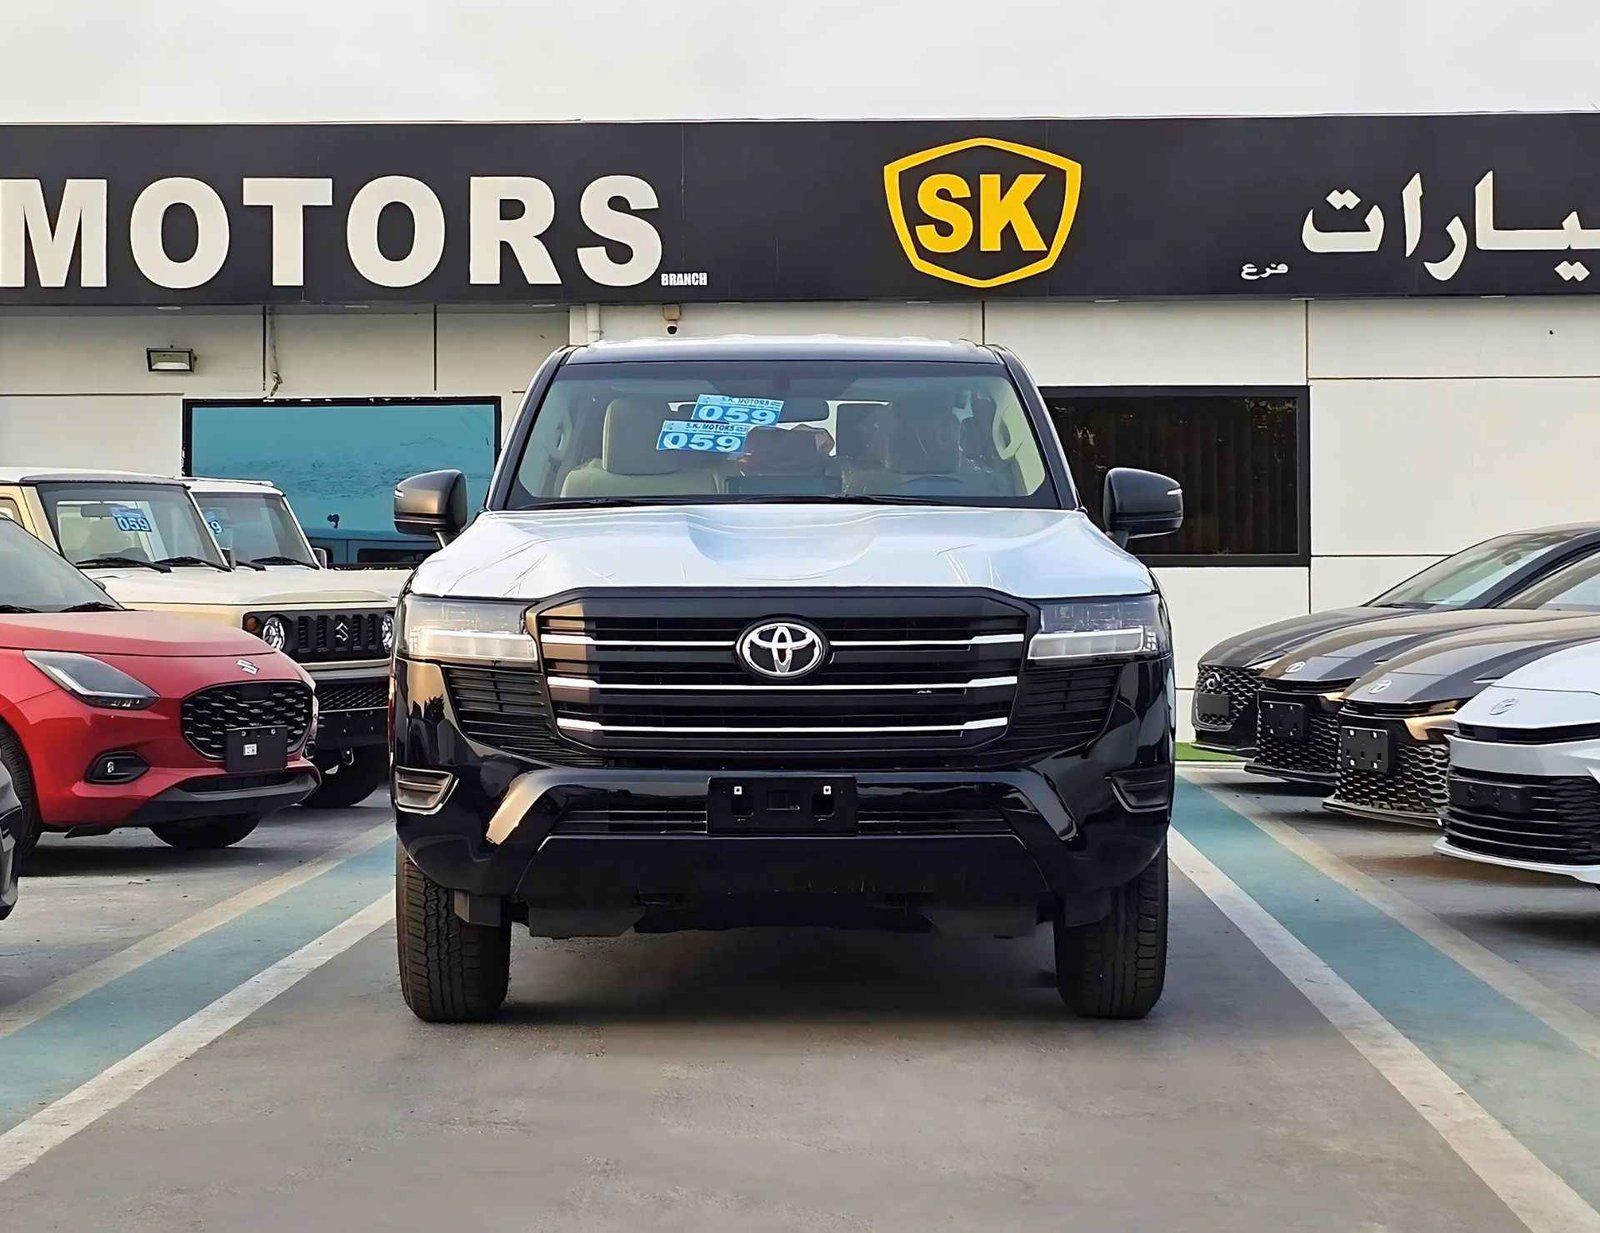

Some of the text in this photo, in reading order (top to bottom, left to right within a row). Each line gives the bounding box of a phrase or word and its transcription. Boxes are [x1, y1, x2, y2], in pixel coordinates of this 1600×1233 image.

[916, 173, 1047, 253] SK
[0, 175, 663, 288] MOTORS
[1301, 171, 1600, 282] يارات
[661, 272, 708, 286] BRANCH
[1240, 263, 1289, 280] فرع
[698, 405, 777, 425] 059
[663, 432, 741, 452] 059
[117, 517, 149, 531] 059
